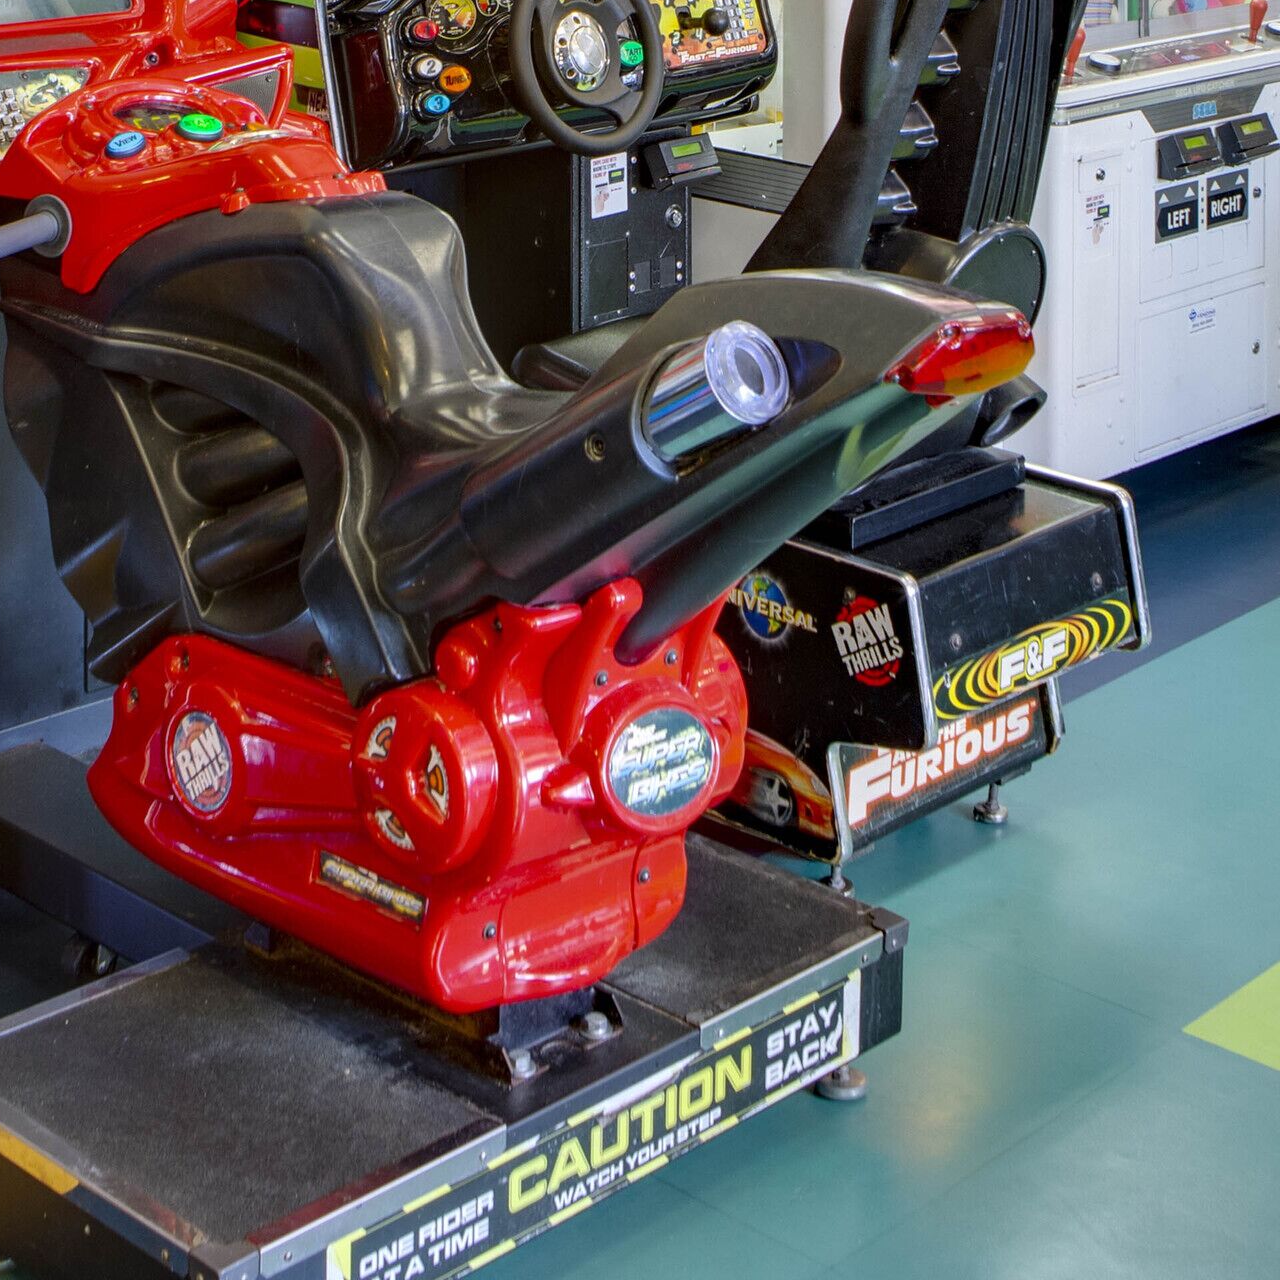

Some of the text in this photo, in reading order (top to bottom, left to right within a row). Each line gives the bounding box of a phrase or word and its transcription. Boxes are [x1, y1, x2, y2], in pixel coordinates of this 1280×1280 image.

[672, 31, 680, 45] 2
[695, 29, 703, 40] 4
[716, 45, 758, 58] FURIOUS
[426, 60, 436, 74] 2
[433, 97, 444, 111] 3
[1193, 100, 1217, 119] SEGA
[115, 133, 137, 147] VIEW
[1168, 208, 1190, 230] LEFT
[1211, 194, 1242, 218] RIGHT
[832, 603, 895, 656] RAW
[842, 637, 904, 677] THRILLS
[999, 628, 1069, 693] F&F
[176, 723, 224, 783] RAW
[612, 731, 701, 778] SUPER
[849, 705, 1034, 827] FURIOUS
[186, 754, 230, 800] THRILLS
[631, 757, 706, 805] BIKES
[766, 1001, 839, 1058] STAY
[508, 1045, 753, 1214] CAUTION
[554, 1109, 721, 1212] WATCH YOUR STEP
[359, 1191, 495, 1277] ONE RIDER
[405, 1221, 491, 1279] A TIME
